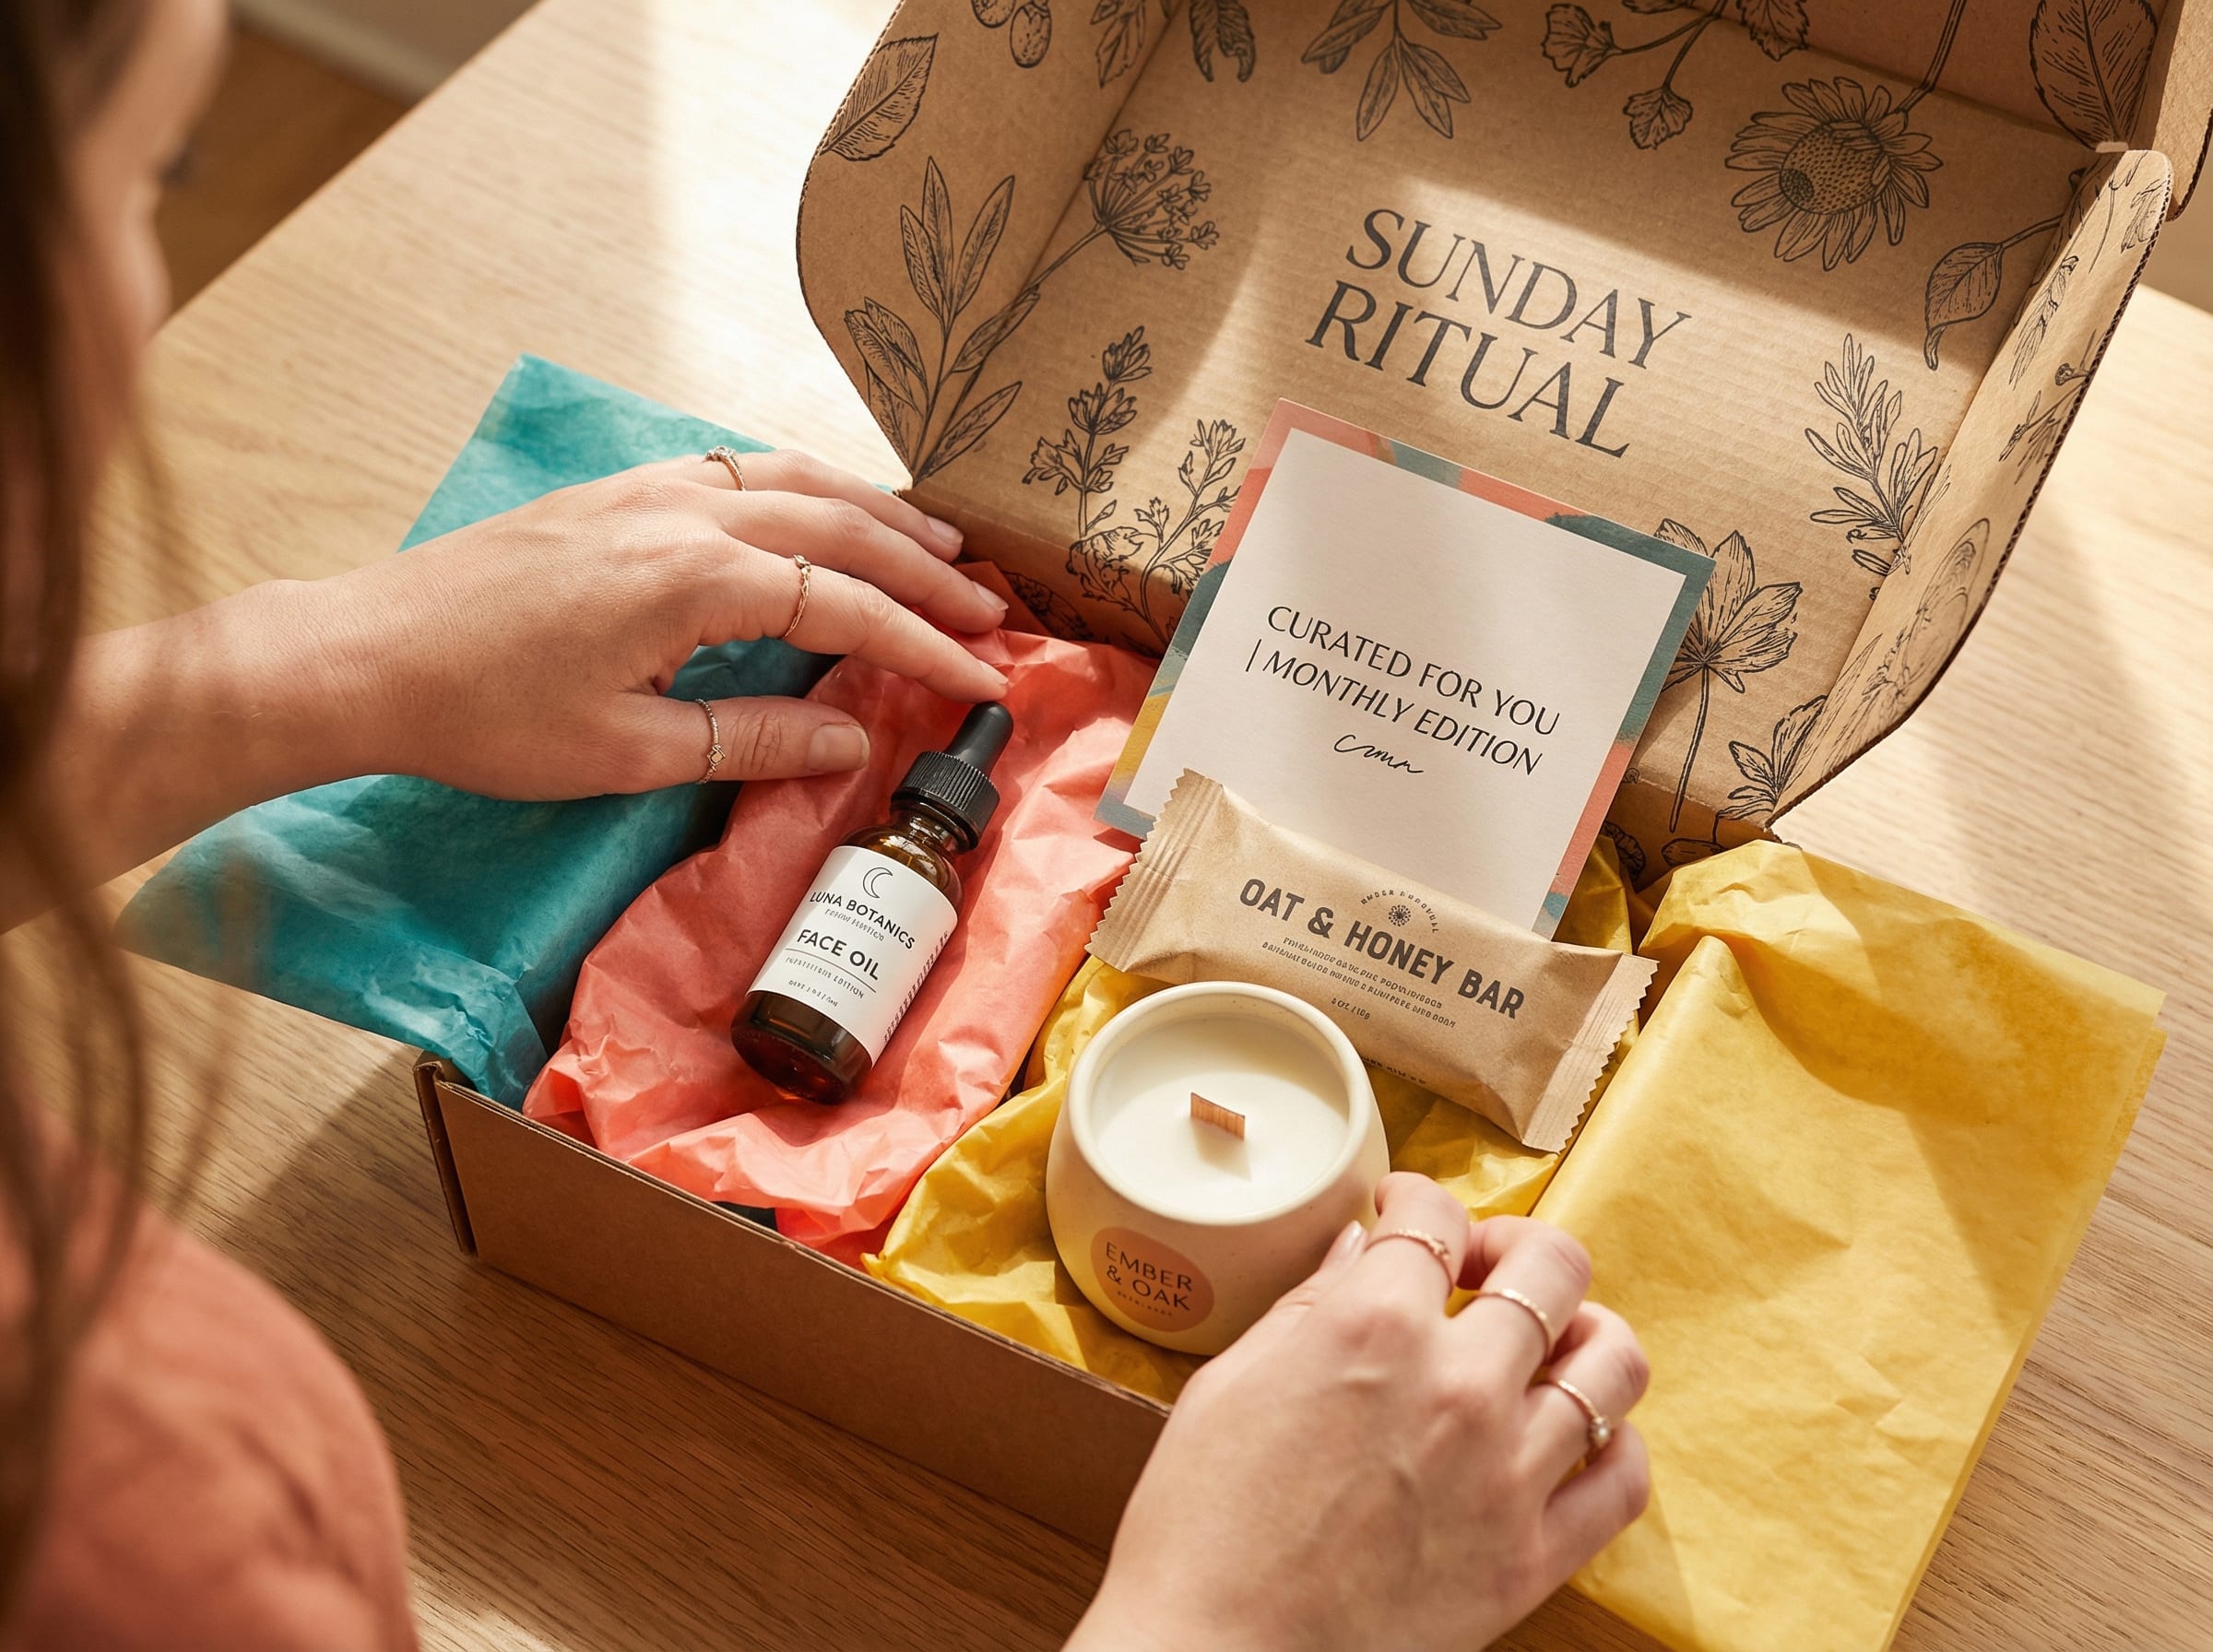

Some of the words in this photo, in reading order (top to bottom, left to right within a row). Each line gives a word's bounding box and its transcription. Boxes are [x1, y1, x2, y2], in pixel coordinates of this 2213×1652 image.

[1345, 208, 1692, 369] SUNDAY
[1306, 279, 1630, 458] RITUAL
[1262, 650, 1414, 723] MONTHLY
[1414, 709, 1542, 775] EDITION
[1268, 606, 1411, 678] CURATED
[1418, 663, 1482, 708] FOR
[1495, 689, 1560, 736] YOU
[797, 929, 846, 956] FACE
[849, 950, 880, 981] OIL
[810, 891, 842, 907] LUNA
[846, 899, 915, 949] BOTANICS
[1239, 879, 1305, 922] OAT
[1308, 906, 1334, 938] &
[1343, 920, 1454, 985] HONEY
[1457, 969, 1525, 1019] BAR
[1106, 1242, 1193, 1292] EMBER
[1106, 1265, 1121, 1285] &
[1132, 1280, 1190, 1311] OAK
